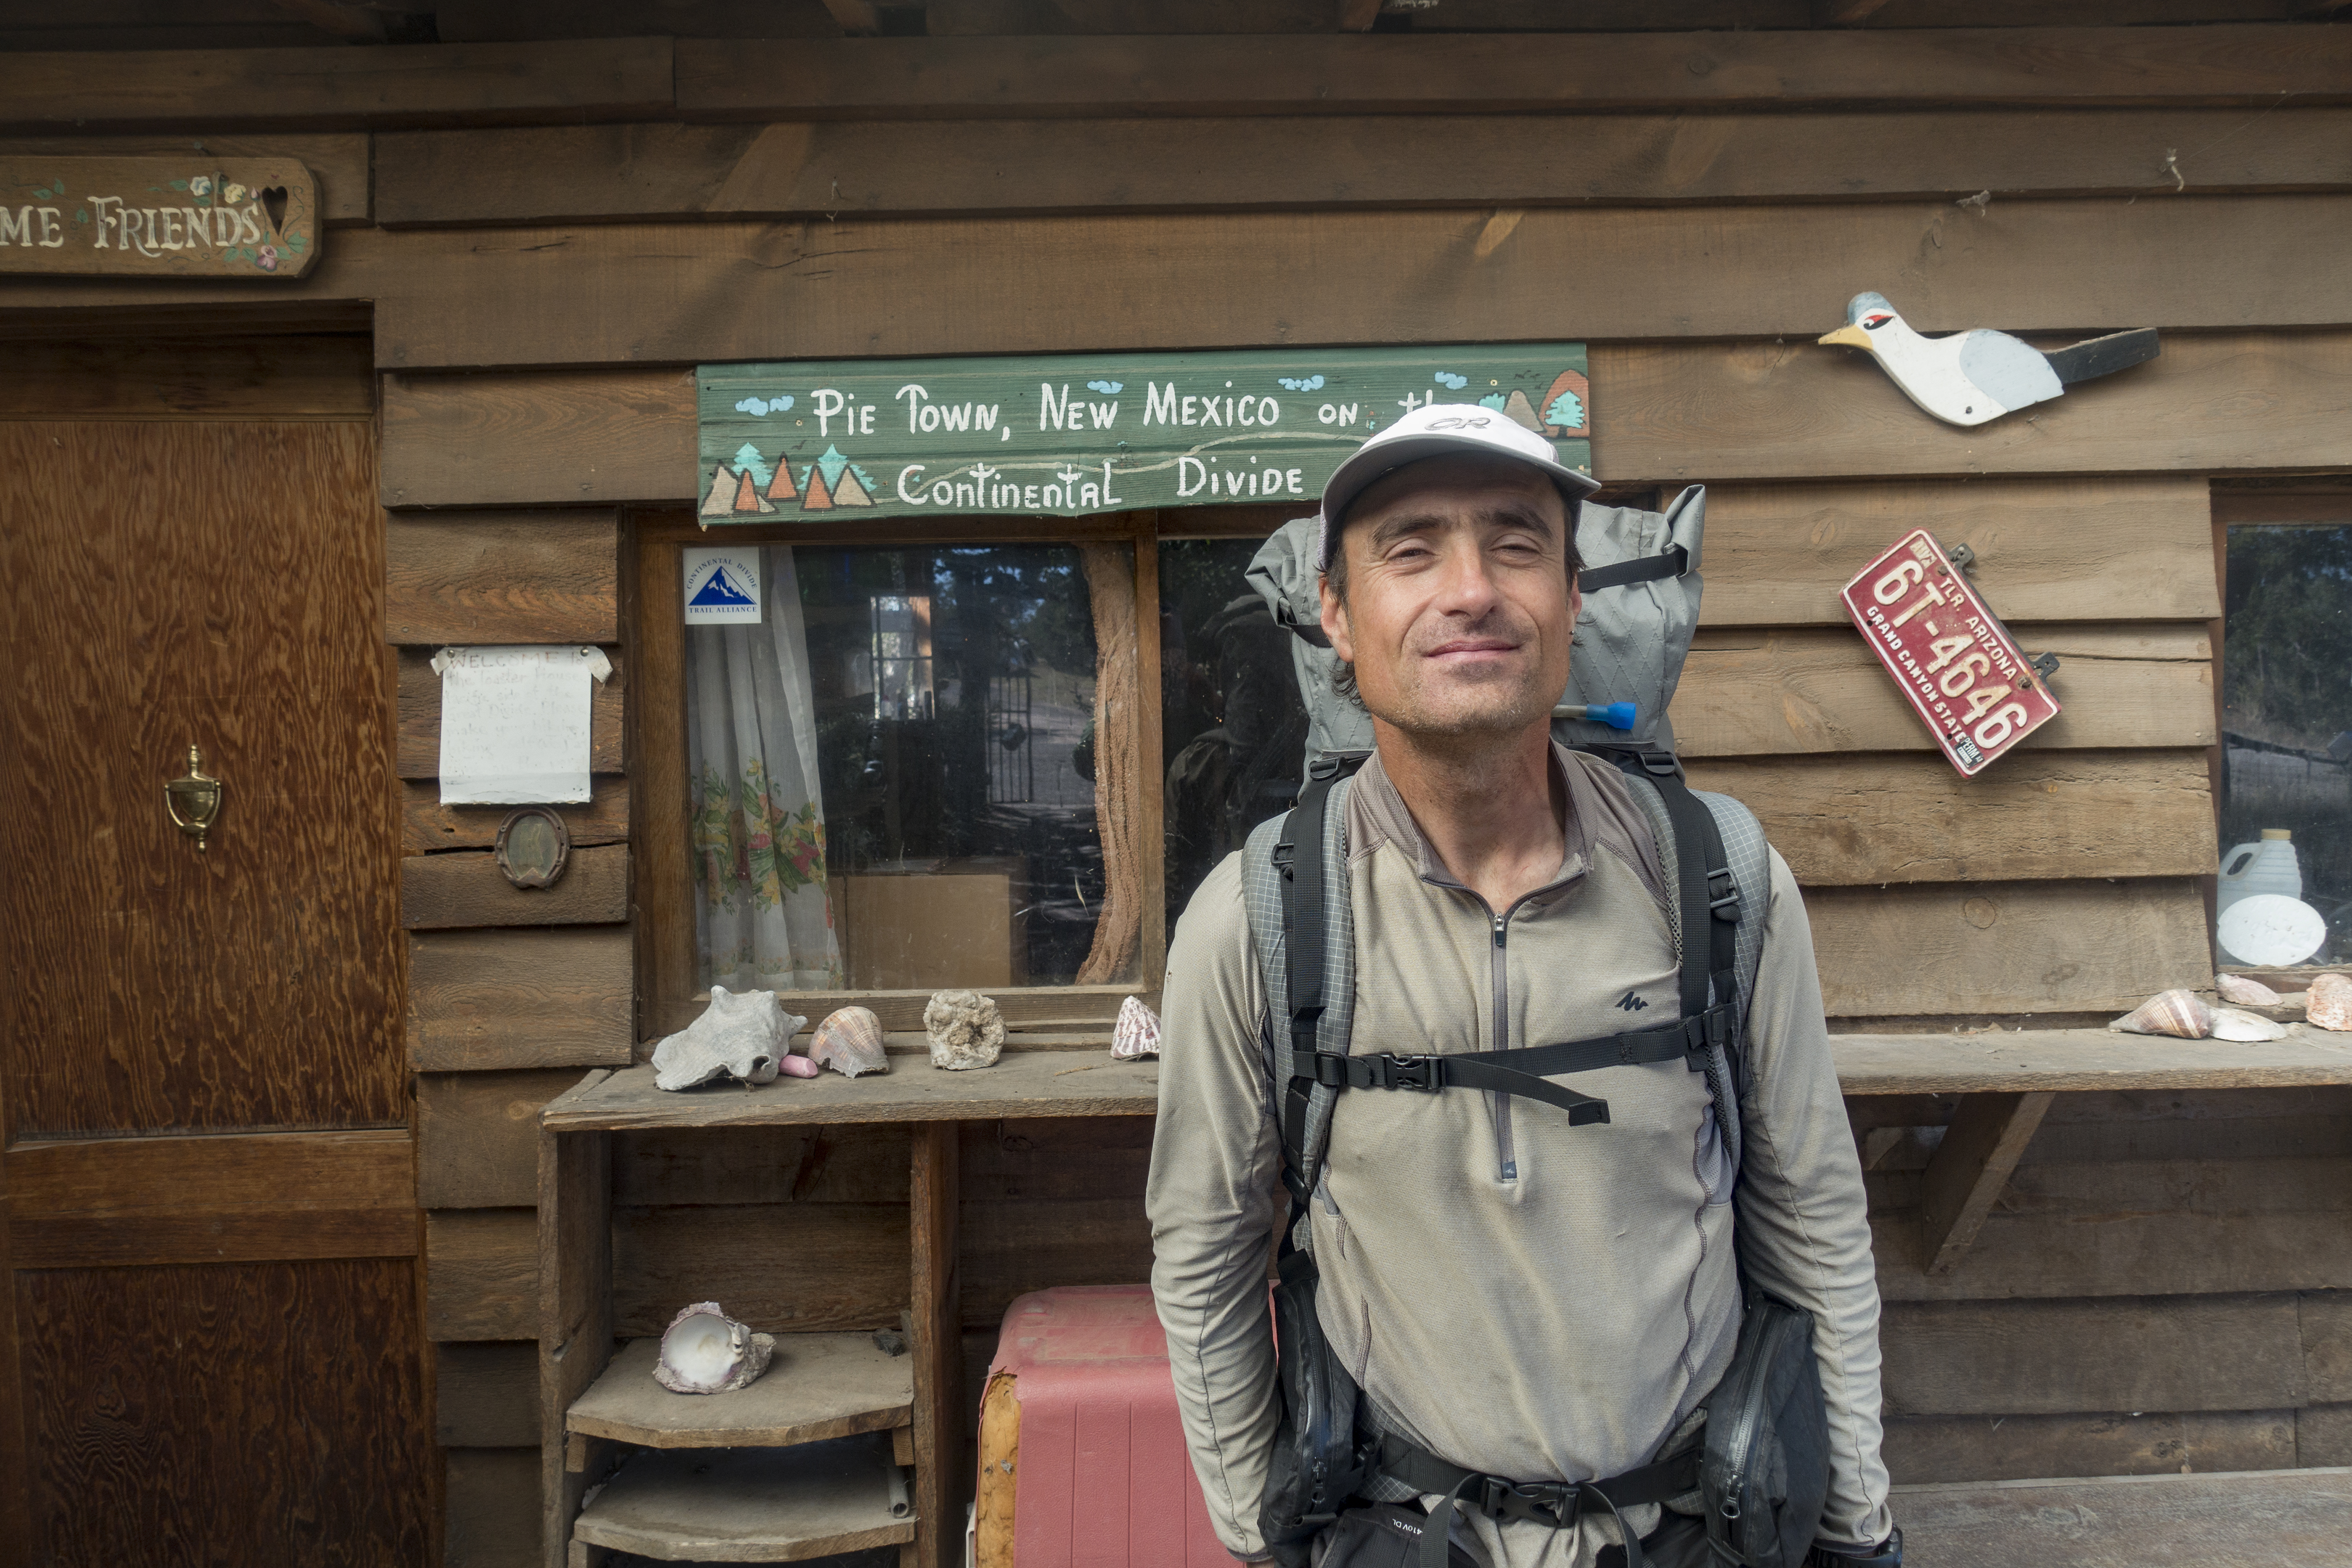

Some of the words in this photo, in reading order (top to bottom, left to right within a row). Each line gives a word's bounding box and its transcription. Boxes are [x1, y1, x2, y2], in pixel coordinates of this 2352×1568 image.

[0, 205, 64, 248] ME
[88, 195, 262, 258] FRIENDS
[1424, 417, 1491, 431] OR
[687, 558, 733, 590] CONTINENTAL
[736, 562, 757, 589] DIVIDE
[450, 651, 559, 669] WELCOME
[1873, 559, 2028, 749] 6T-4646
[1966, 616, 2018, 681] ARIZONA
[1867, 605, 1902, 650] GRAND
[1898, 650, 1939, 703] CANYON
[1934, 703, 1966, 742] STATE
[1961, 736, 1979, 759] PERM
